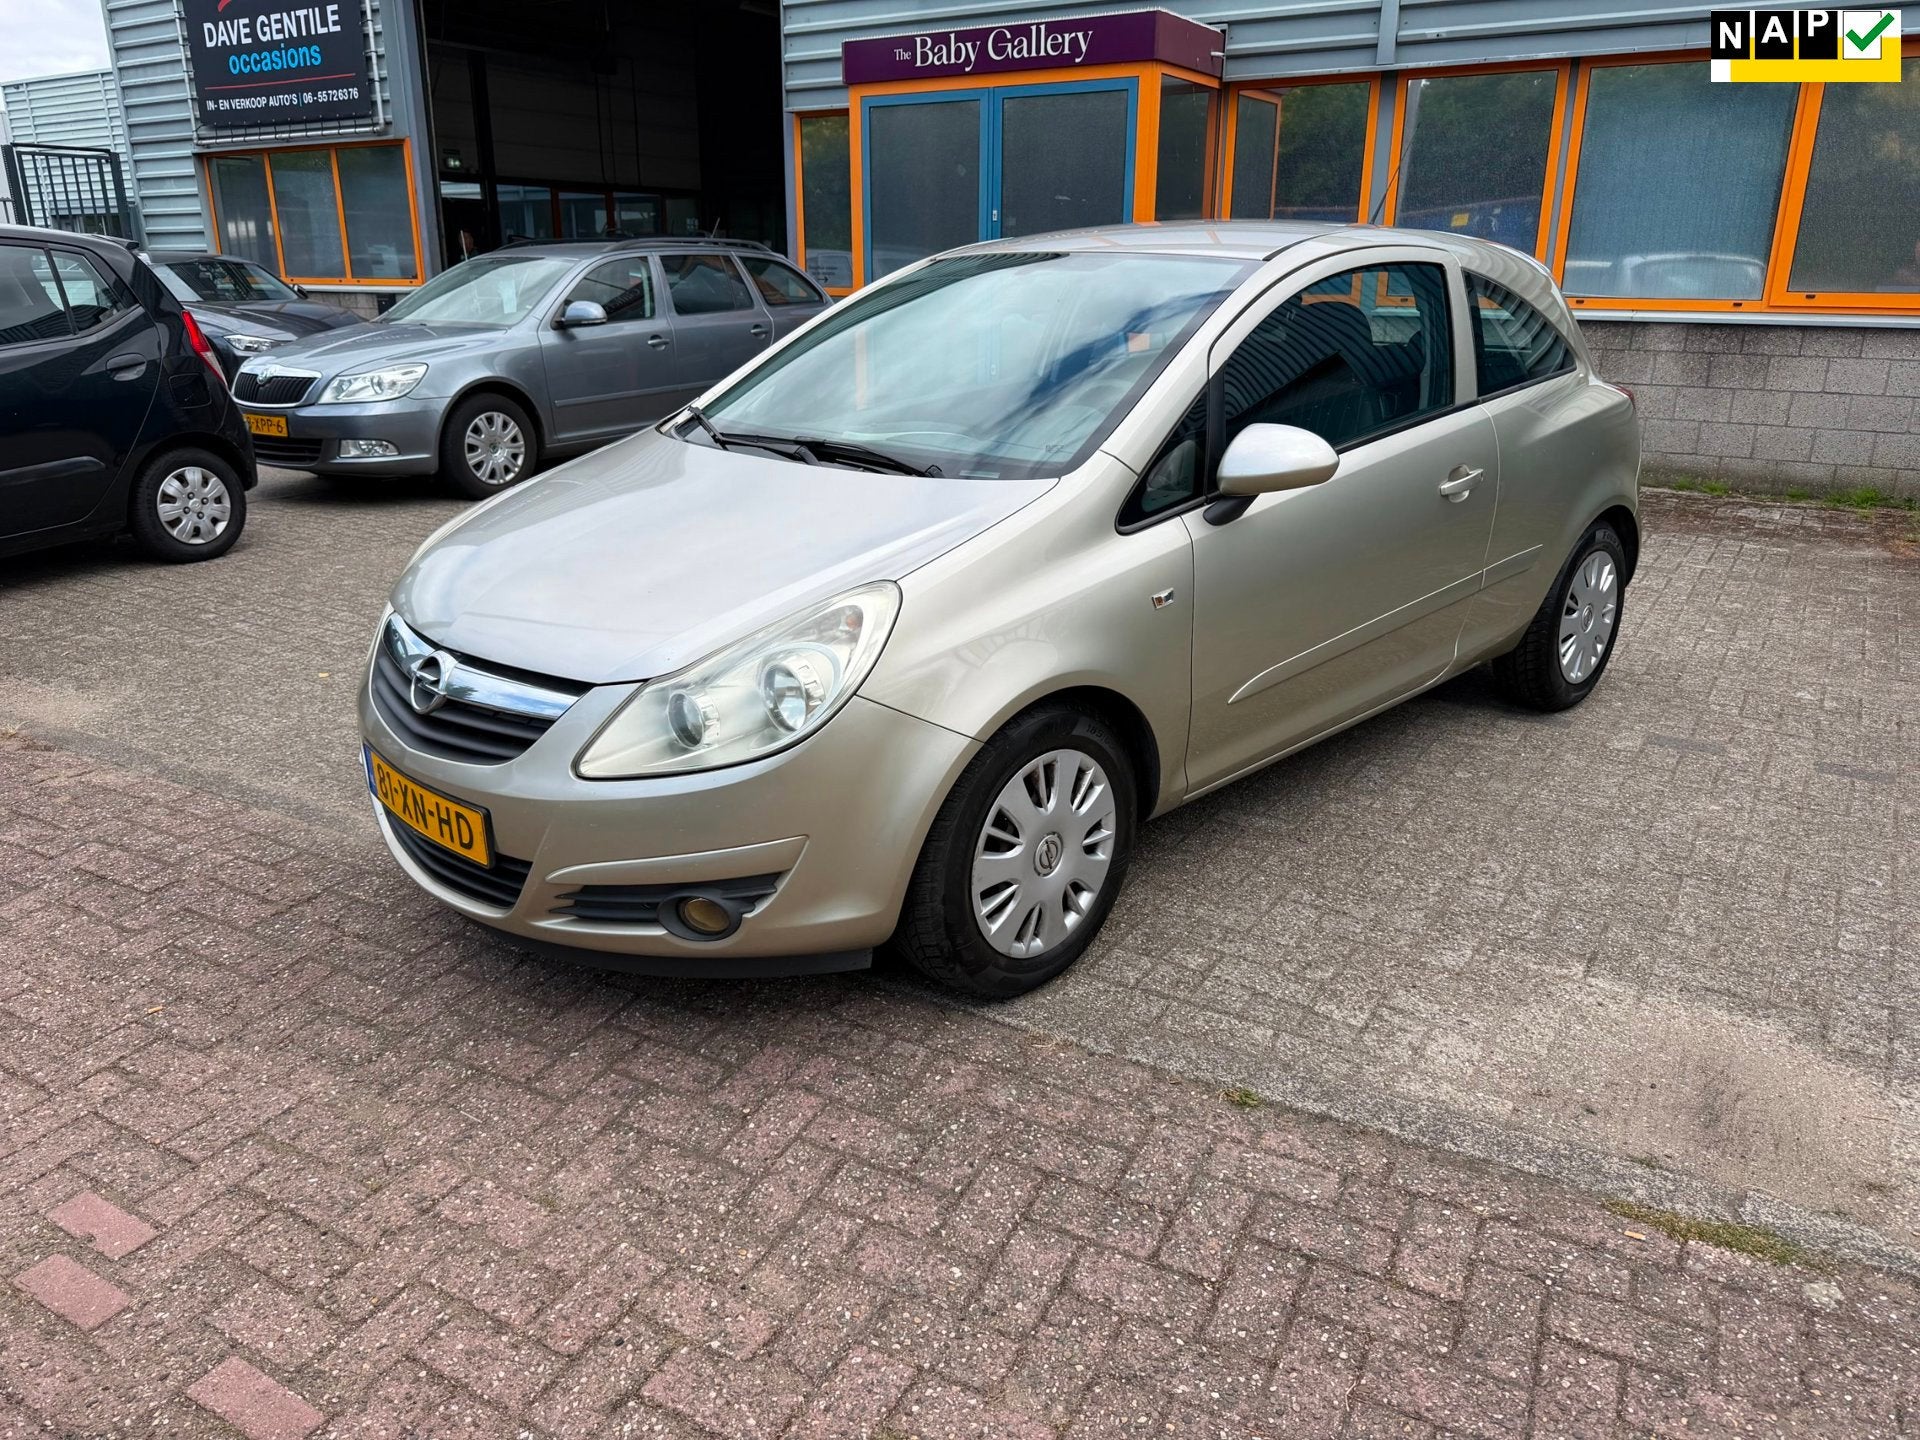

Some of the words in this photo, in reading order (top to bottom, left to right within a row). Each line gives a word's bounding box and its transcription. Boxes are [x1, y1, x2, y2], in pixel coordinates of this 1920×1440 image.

[203, 17, 252, 48] DAVE
[256, 4, 341, 42] GENTILE
[894, 49, 912, 61] The
[914, 33, 981, 72] Baby
[987, 23, 1094, 63] Gallery
[228, 43, 322, 75] occasions
[206, 99, 218, 111] IN-
[219, 99, 230, 111] EN
[231, 96, 267, 109] VERKOOP
[269, 94, 298, 107] AUTO'S
[376, 762, 474, 850] 81-XN-HD
